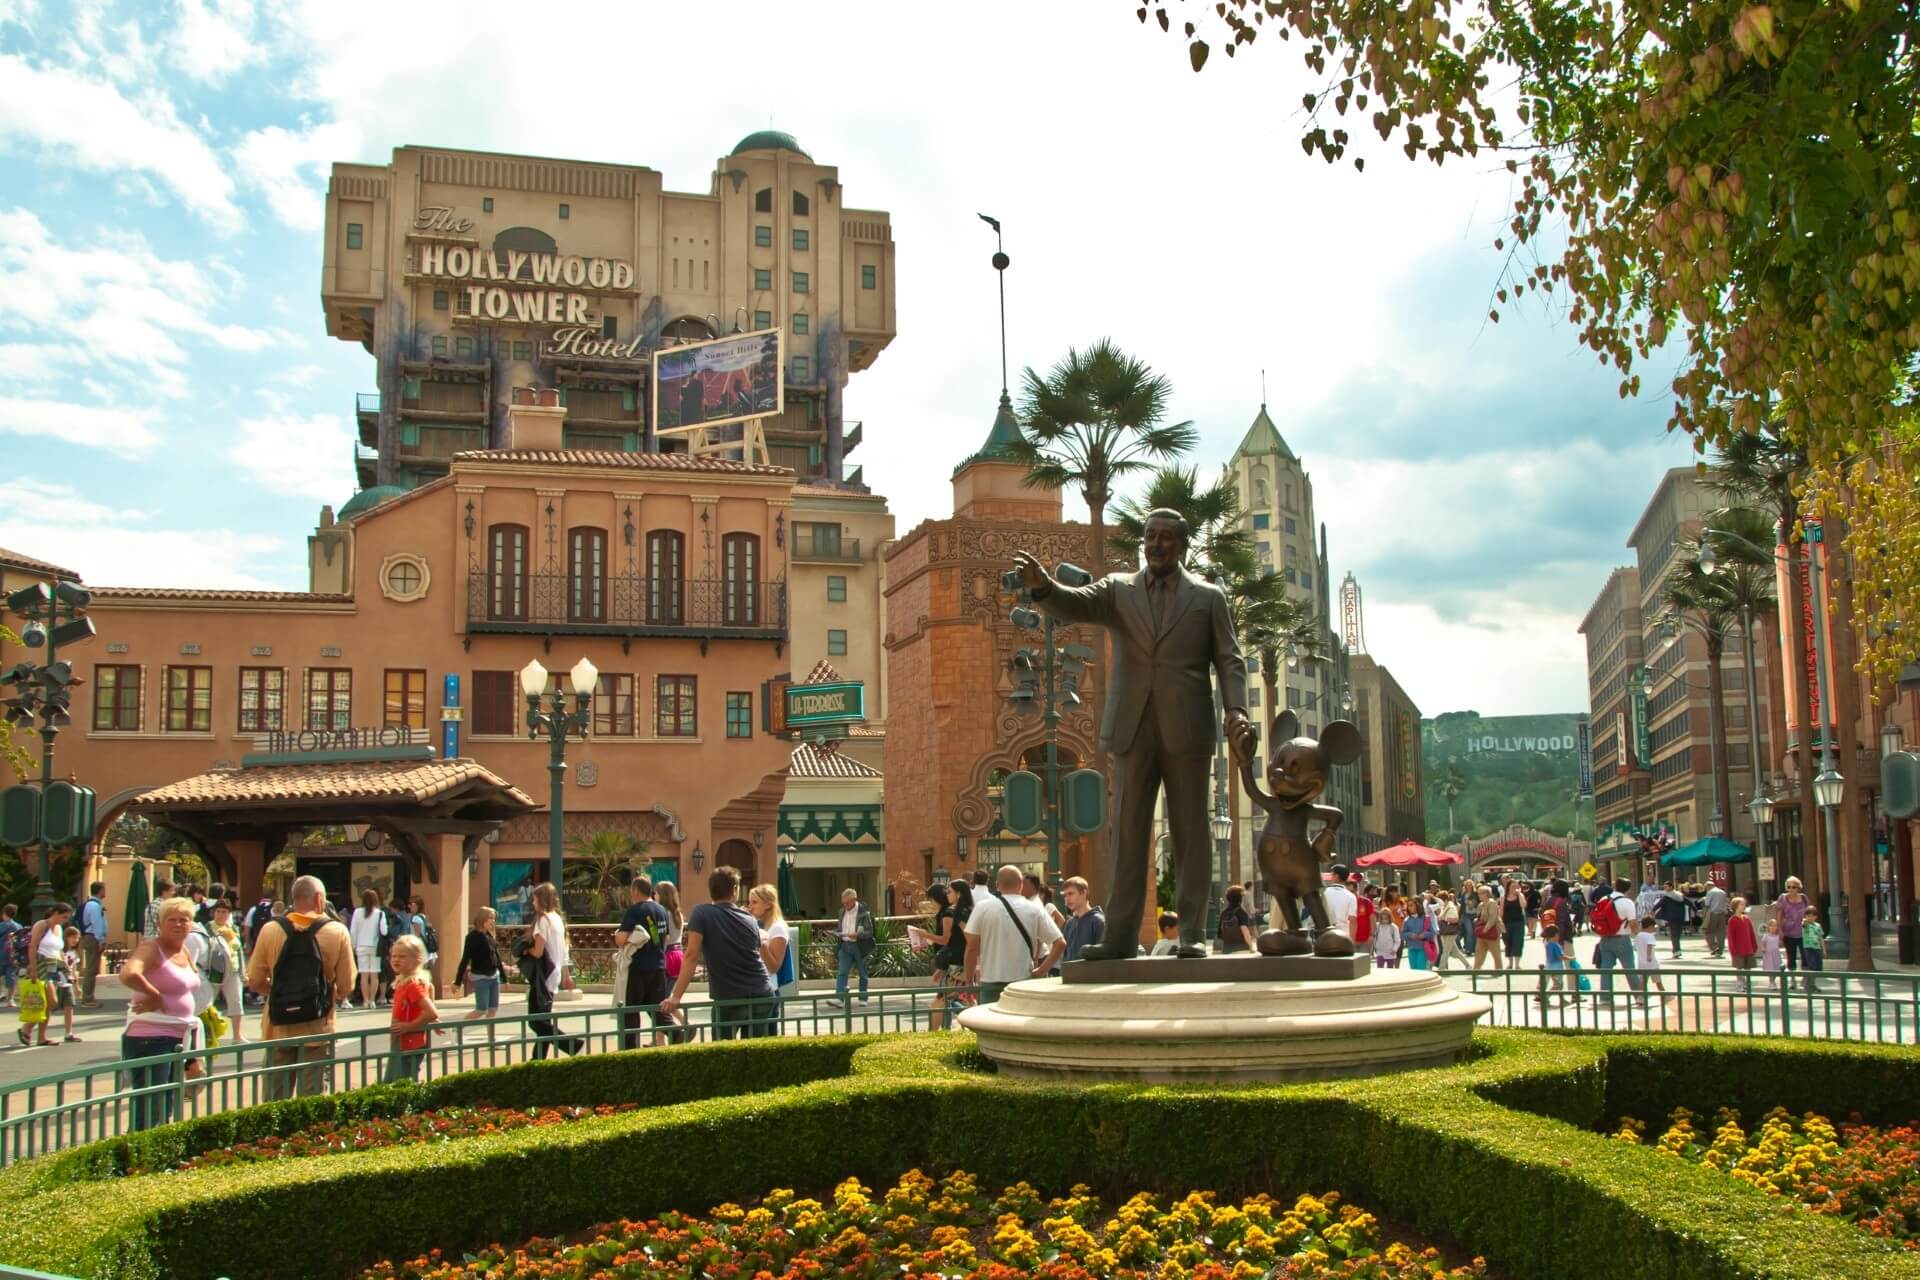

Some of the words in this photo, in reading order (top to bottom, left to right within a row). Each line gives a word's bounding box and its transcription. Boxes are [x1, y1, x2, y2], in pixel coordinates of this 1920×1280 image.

[413, 206, 474, 233] The
[420, 245, 635, 289] HOLLYWOOD
[467, 285, 590, 325] TOWER
[547, 327, 645, 359] Hotel
[1345, 592, 1357, 647] CAPITAN
[268, 725, 413, 753] INFORMATION
[1467, 735, 1575, 752] HOLLYWOOD
[1638, 698, 1649, 764] HOTEL
[1708, 870, 1728, 881] STO
